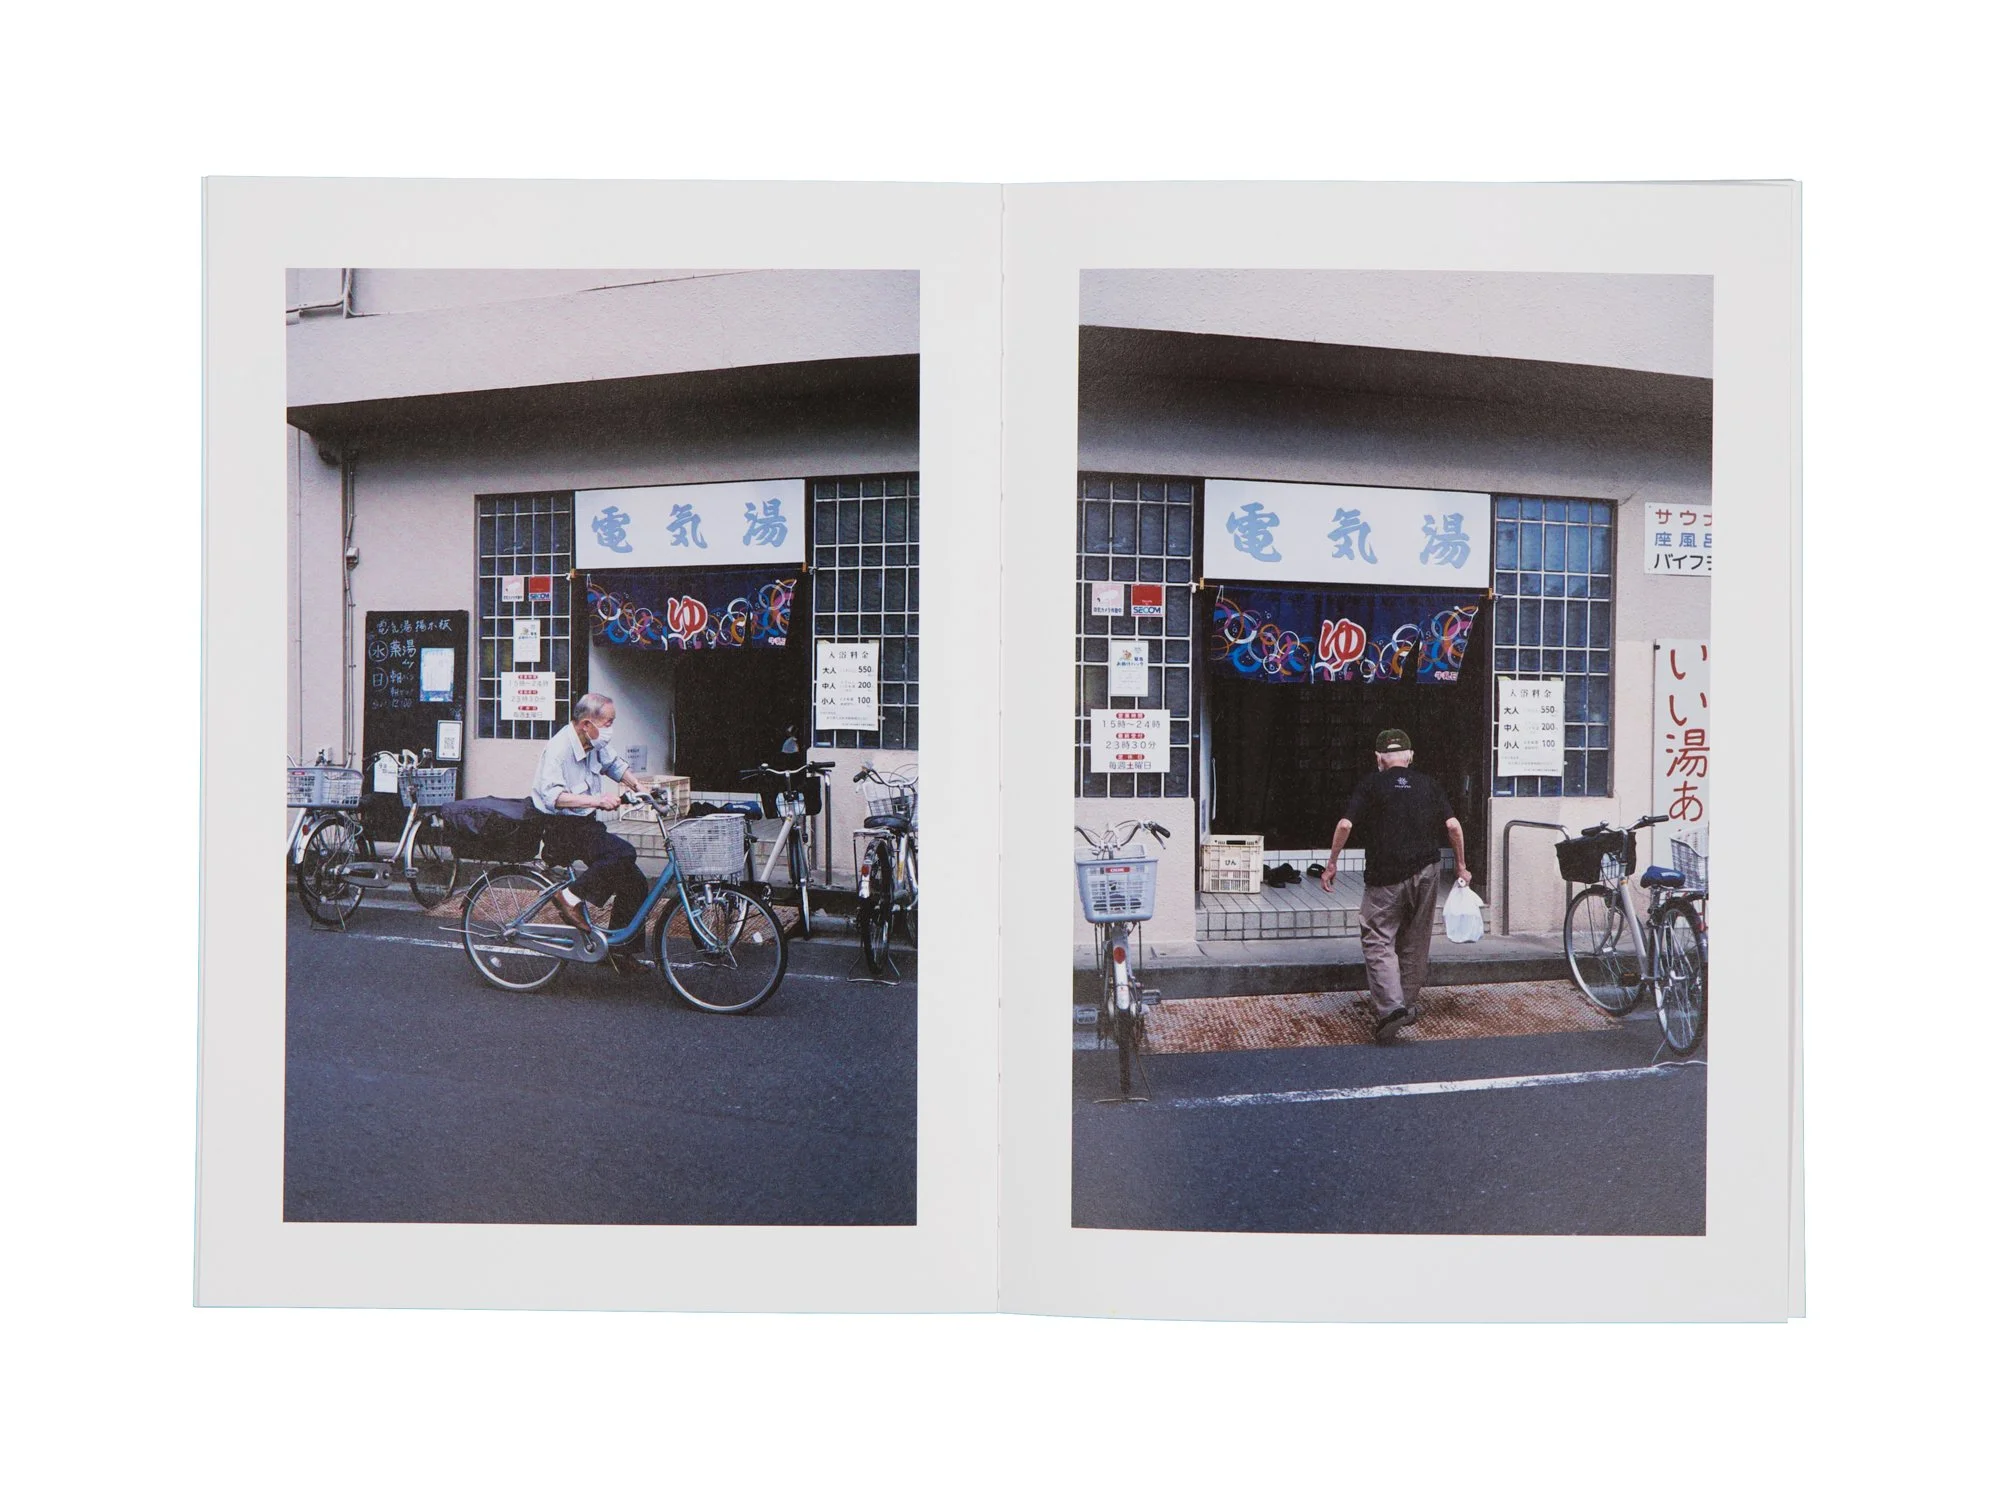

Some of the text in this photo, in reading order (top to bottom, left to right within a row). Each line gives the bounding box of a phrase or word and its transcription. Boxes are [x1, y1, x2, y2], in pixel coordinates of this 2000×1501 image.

[592, 498, 788, 553] 電気湯
[1226, 502, 1472, 569] 電気湯
[1133, 606, 1161, 614] SECOM
[667, 595, 708, 641] ゆ
[1317, 618, 1366, 671] ゆ
[858, 665, 872, 673] 550
[822, 682, 836, 690] 中人
[857, 681, 872, 689] 200
[1510, 689, 1552, 698] 入浴料金
[857, 696, 871, 704] 100
[1504, 705, 1555, 715] 大人 550
[1504, 722, 1555, 732] 中人 200
[1105, 740, 1156, 749] 23時30分
[1504, 741, 1520, 750] 小人
[1542, 740, 1556, 748] 100
